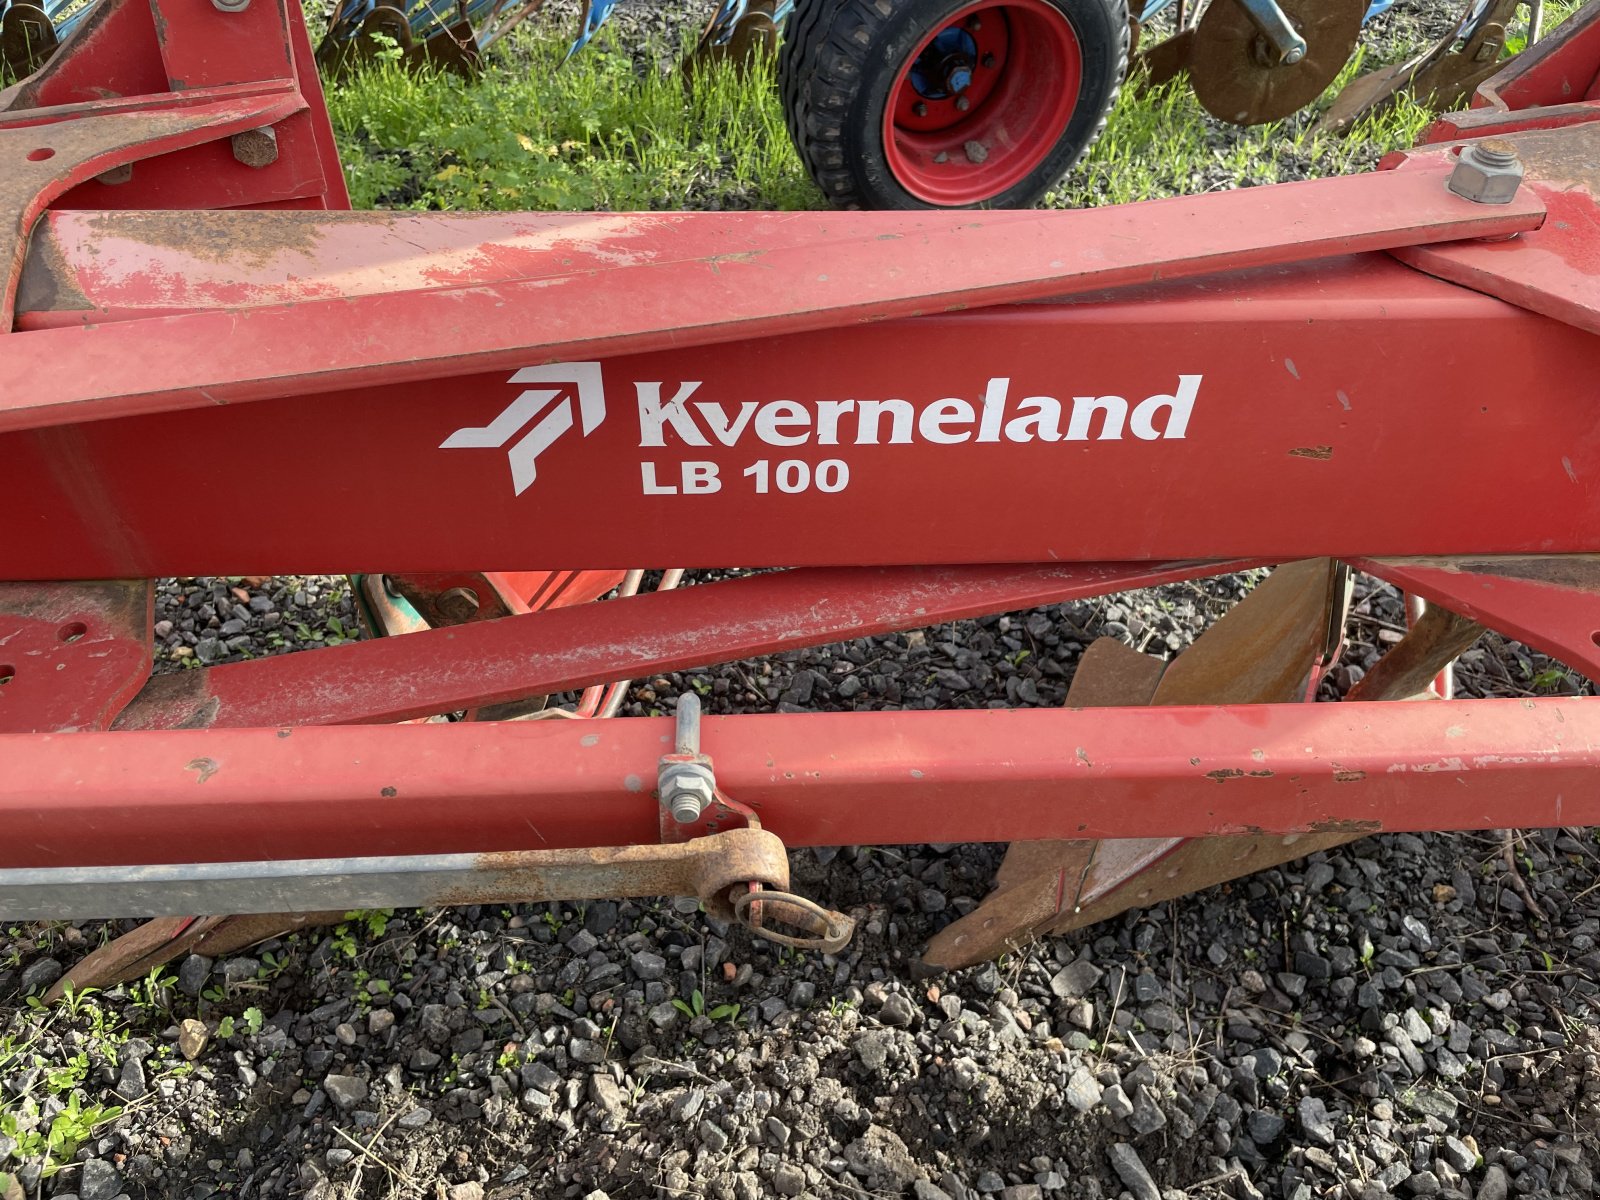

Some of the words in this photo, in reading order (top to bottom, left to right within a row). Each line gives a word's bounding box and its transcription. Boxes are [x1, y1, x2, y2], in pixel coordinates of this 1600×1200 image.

[634, 375, 1203, 446] Kverneland
[641, 462, 721, 494] LB
[744, 459, 850, 493] 100
